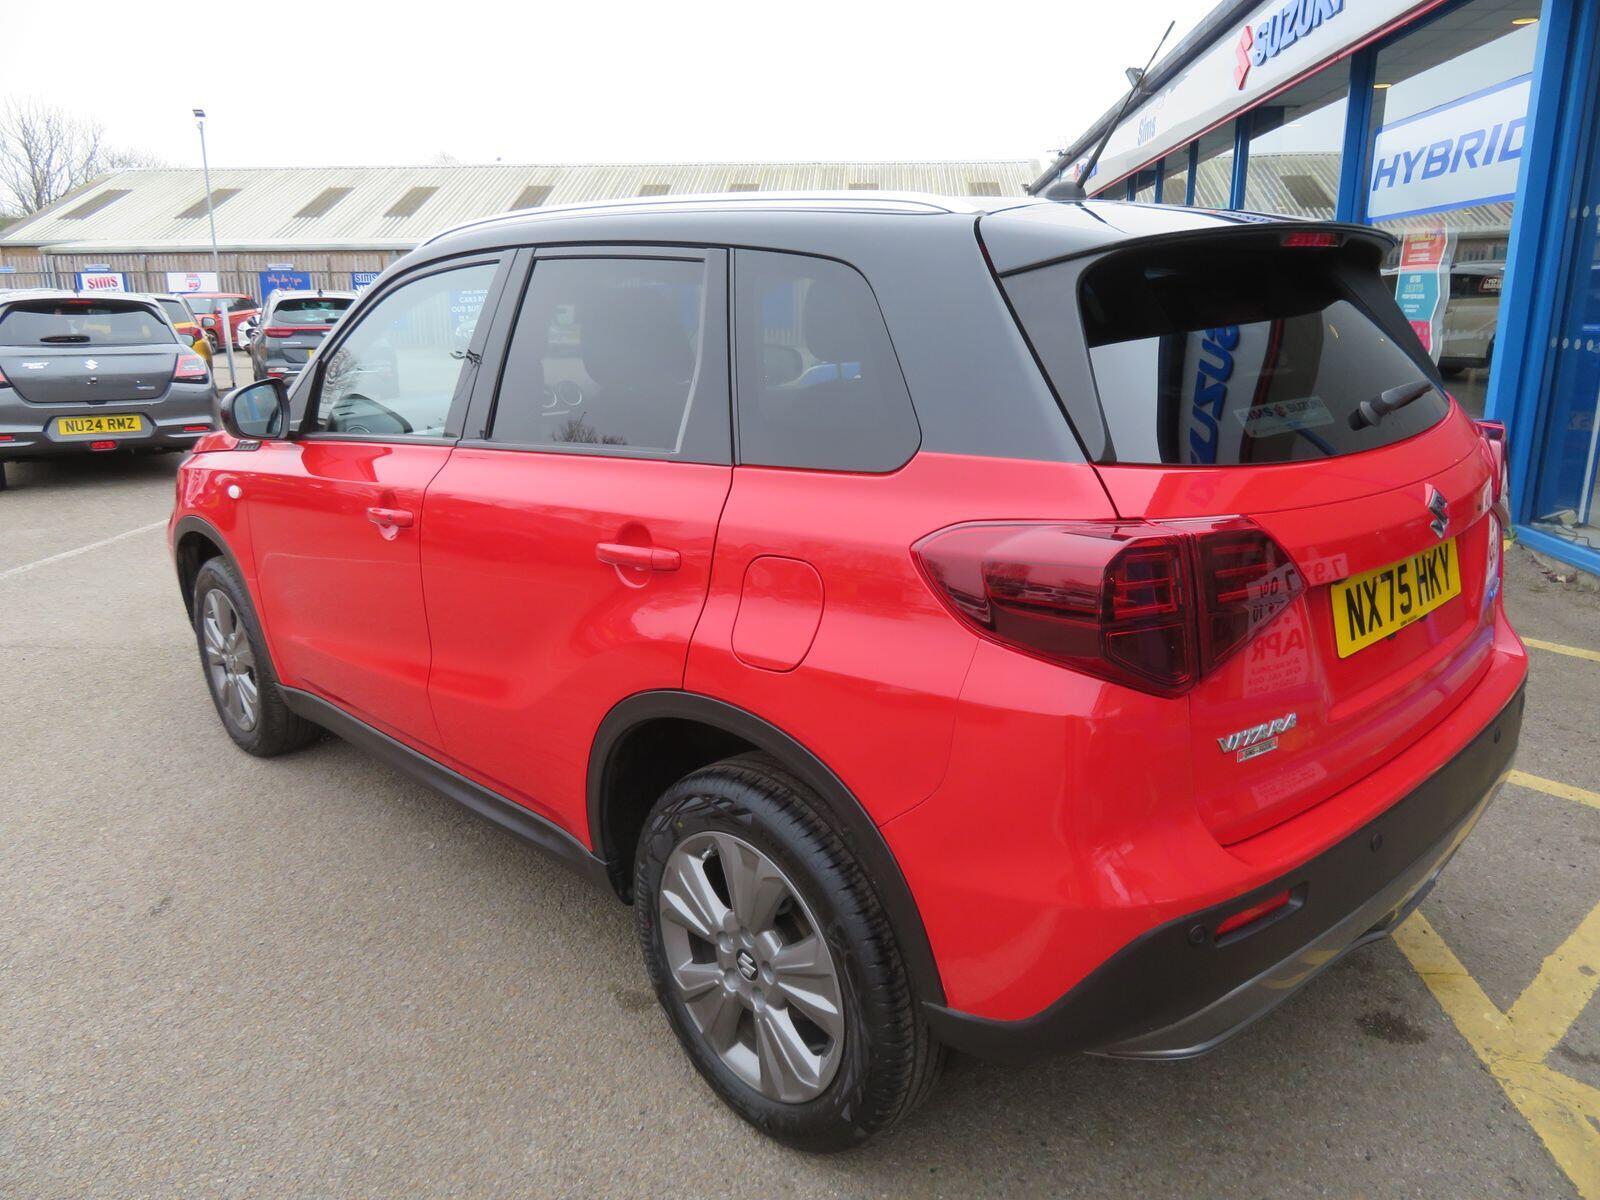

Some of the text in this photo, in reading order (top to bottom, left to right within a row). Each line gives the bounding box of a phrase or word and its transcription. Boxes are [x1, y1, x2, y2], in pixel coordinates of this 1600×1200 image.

[1372, 116, 1527, 192] HYBRID
[65, 417, 135, 433] NU24 RMZ
[1345, 563, 1413, 642] NX75
[1414, 542, 1450, 607] HKY
[1217, 711, 1297, 754] VITARA
